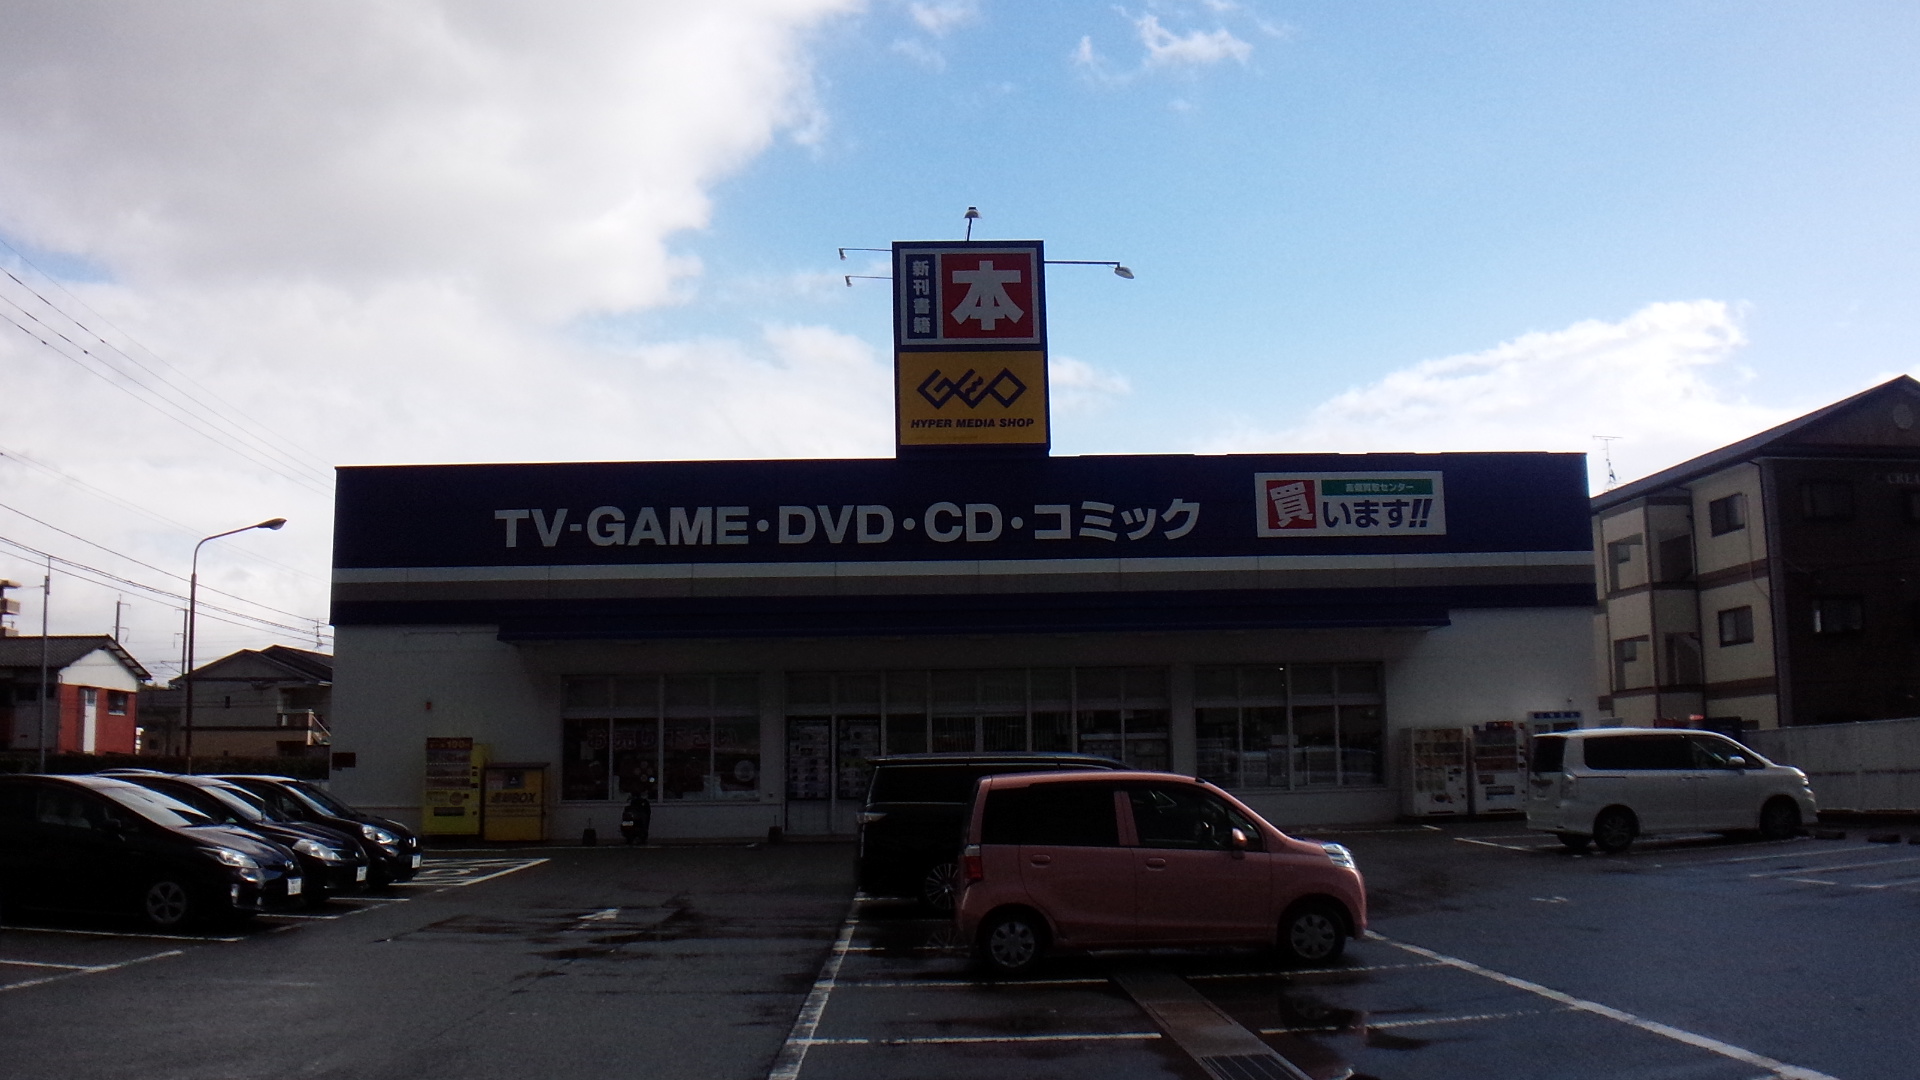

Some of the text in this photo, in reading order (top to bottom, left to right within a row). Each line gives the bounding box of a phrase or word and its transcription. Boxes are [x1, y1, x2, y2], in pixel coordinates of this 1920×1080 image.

[912, 260, 931, 333] 新刊書籍
[951, 260, 1024, 330] 本
[916, 367, 1027, 410] GEO
[910, 418, 1035, 429] HYPER MEDIA SHOP
